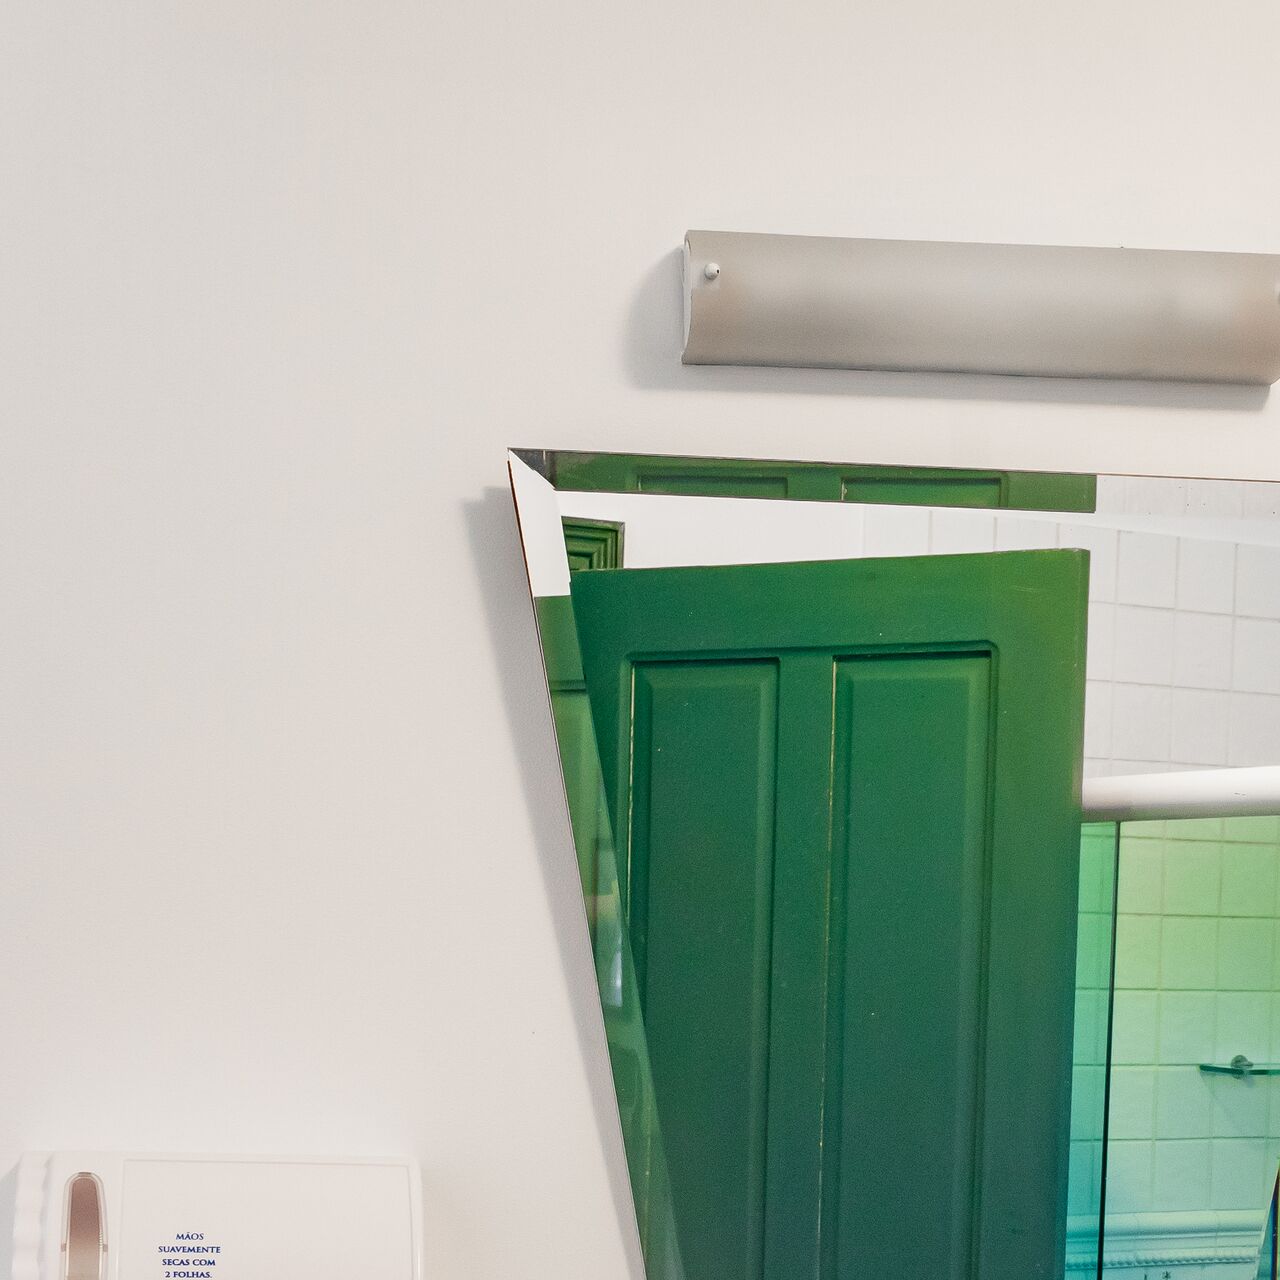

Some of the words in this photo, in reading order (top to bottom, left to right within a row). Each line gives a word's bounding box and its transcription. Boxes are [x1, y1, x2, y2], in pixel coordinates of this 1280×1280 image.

[176, 1231, 204, 1241] MÃOS
[158, 1246, 221, 1254] SUAVEMENTE
[162, 1258, 190, 1266] SECAS
[192, 1258, 216, 1266] COM
